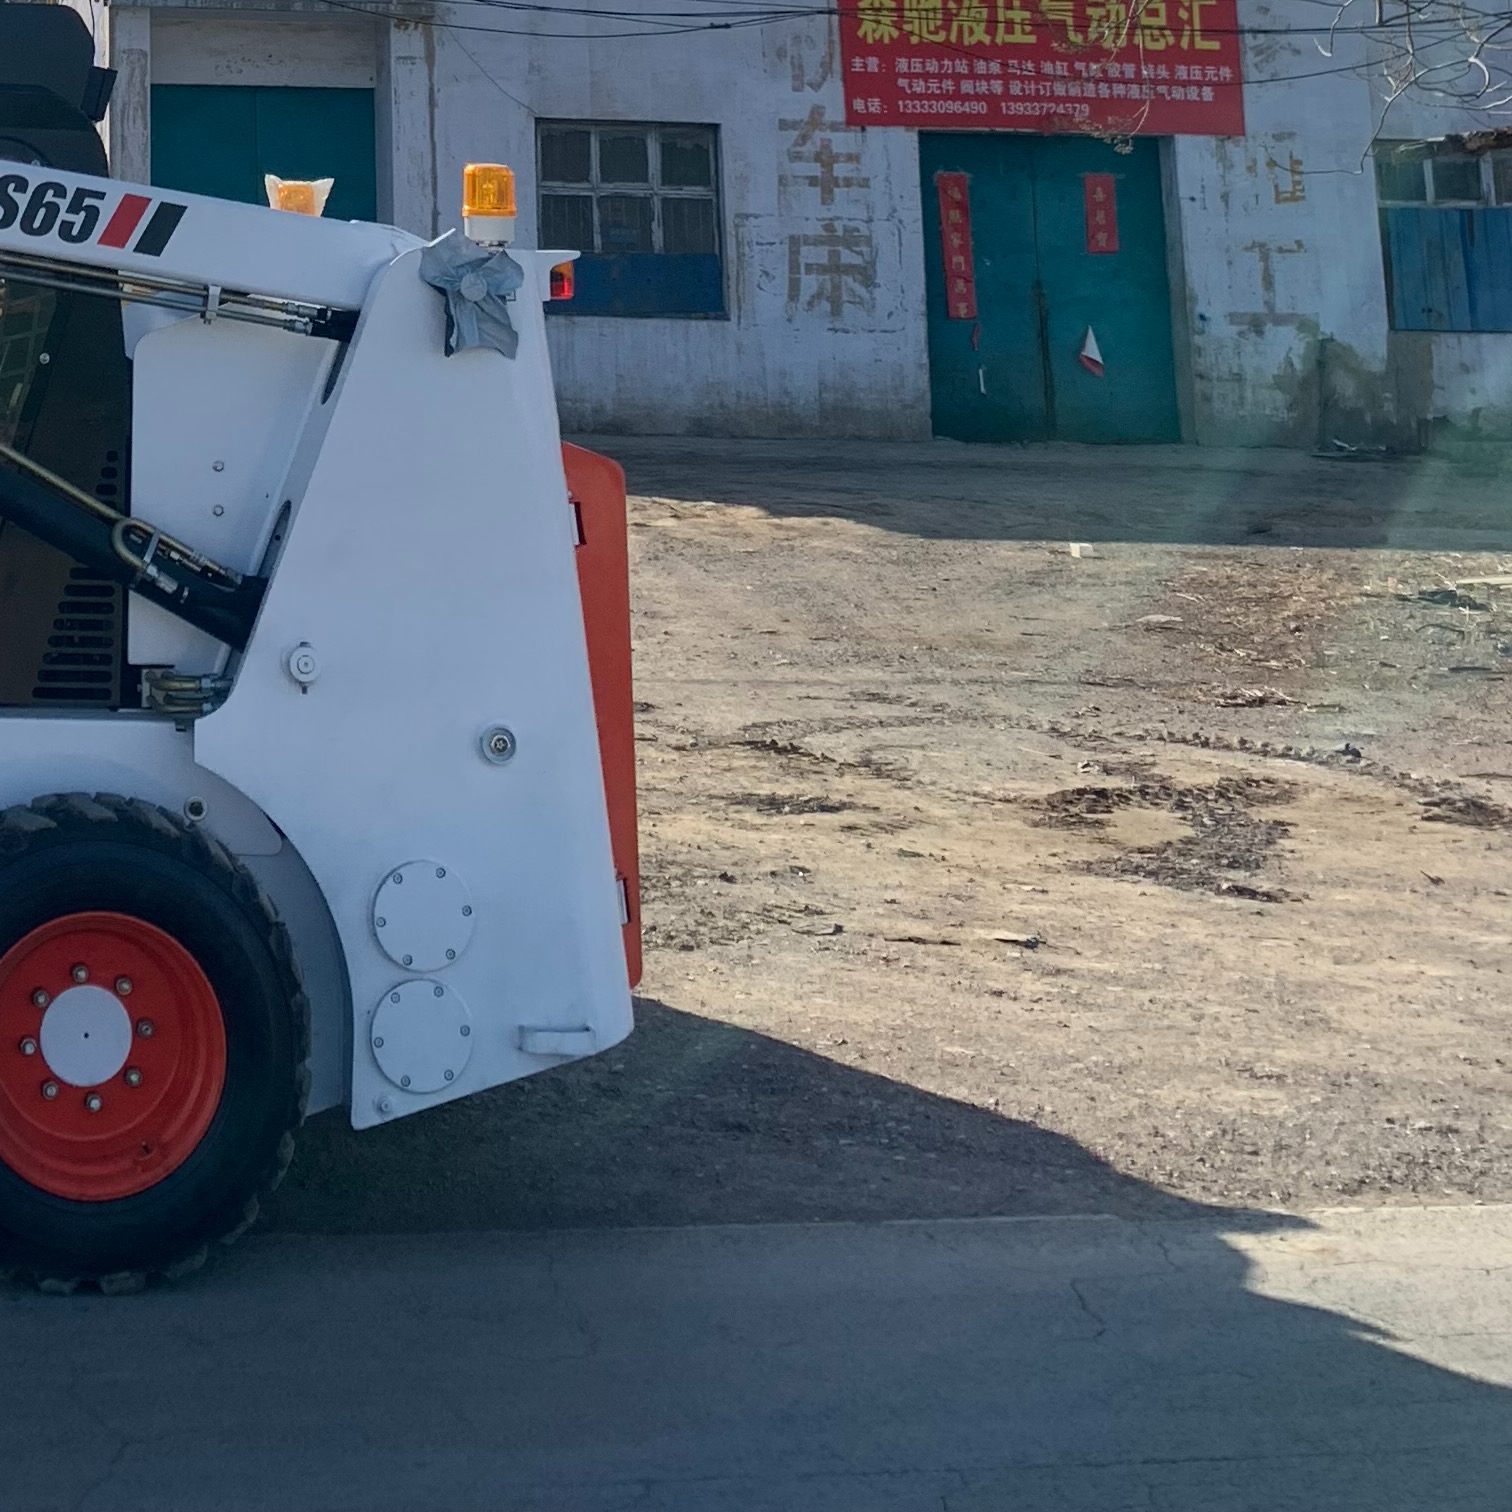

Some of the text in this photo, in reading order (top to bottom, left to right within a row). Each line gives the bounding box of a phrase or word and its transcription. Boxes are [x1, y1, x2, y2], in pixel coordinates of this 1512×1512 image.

[895, 57, 969, 74] 液压动力站
[973, 59, 1002, 75] 油泵
[1007, 60, 1036, 76] 马达
[1175, 64, 1233, 82] 液压元件
[896, 78, 956, 95] 气动元件
[898, 99, 987, 115] 13333096490
